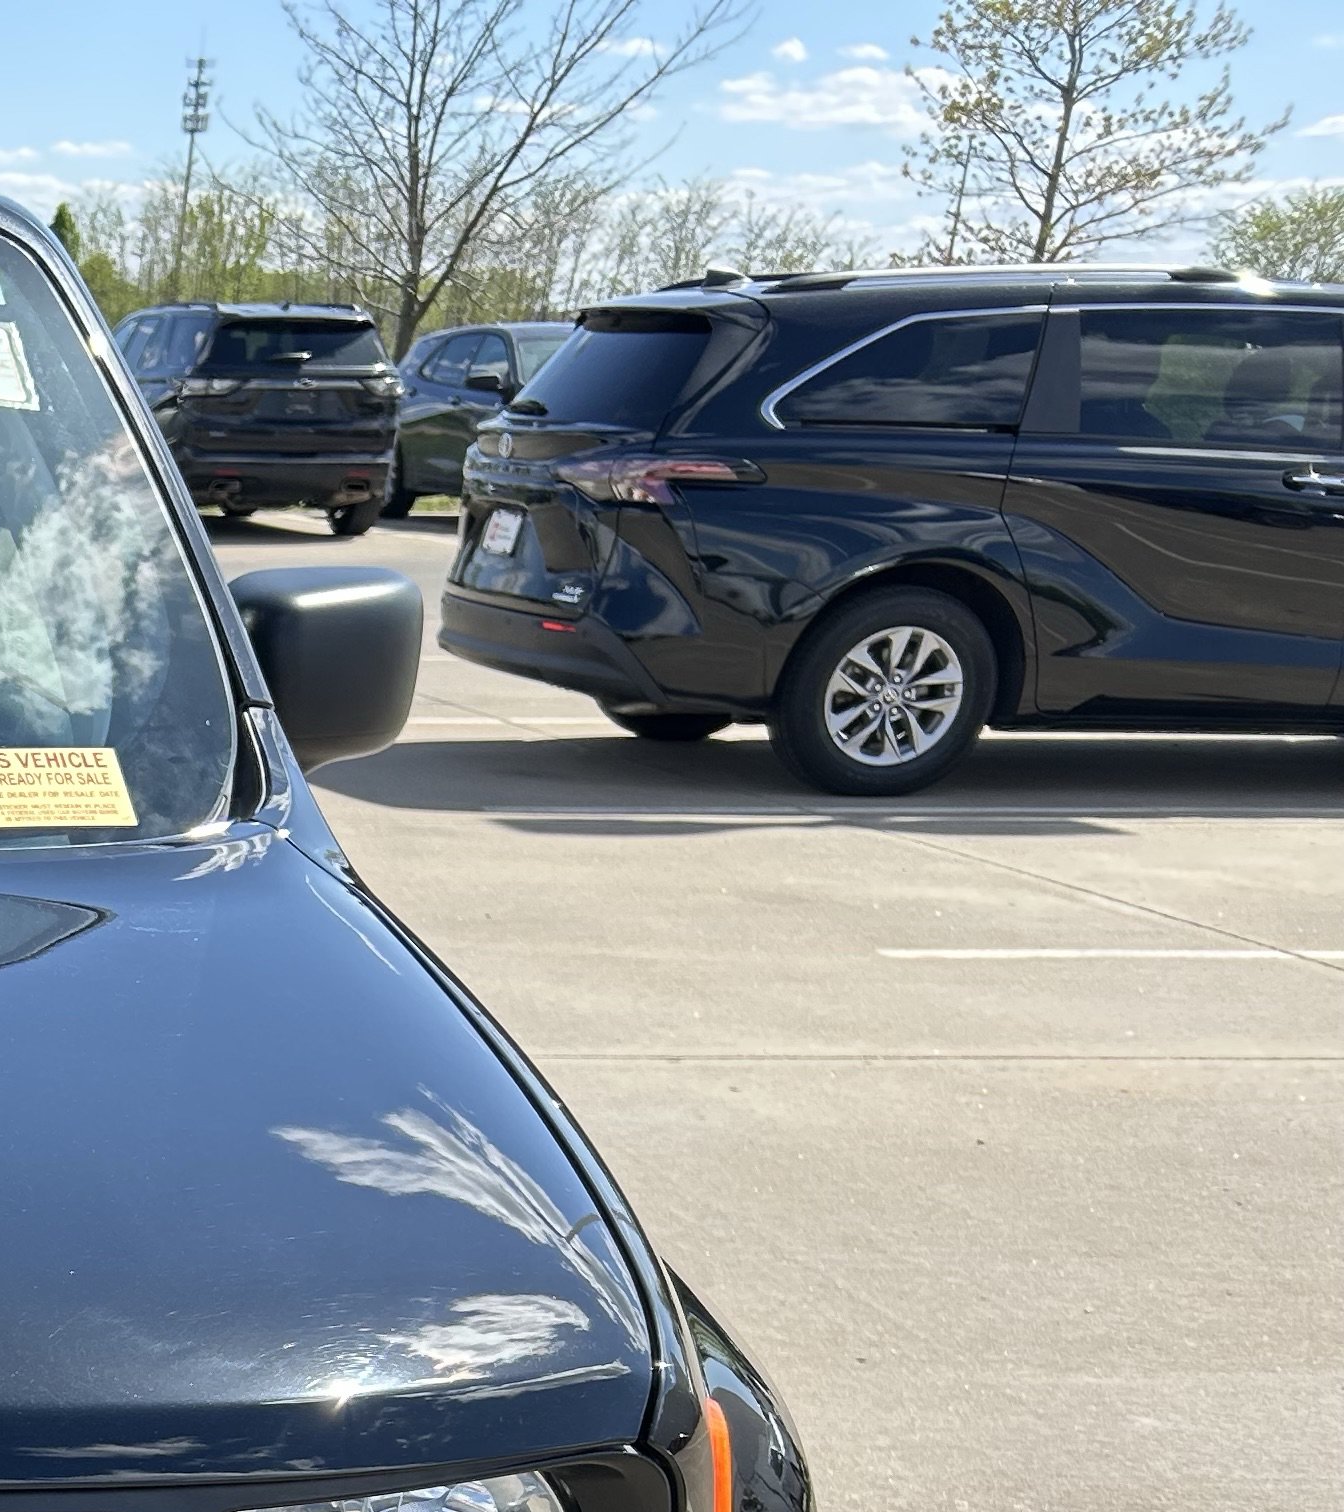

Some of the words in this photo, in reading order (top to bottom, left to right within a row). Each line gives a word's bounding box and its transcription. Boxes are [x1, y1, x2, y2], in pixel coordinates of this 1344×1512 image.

[14, 751, 108, 768] VEHICLE
[45, 772, 75, 785] FOR
[76, 772, 112, 785] SALE
